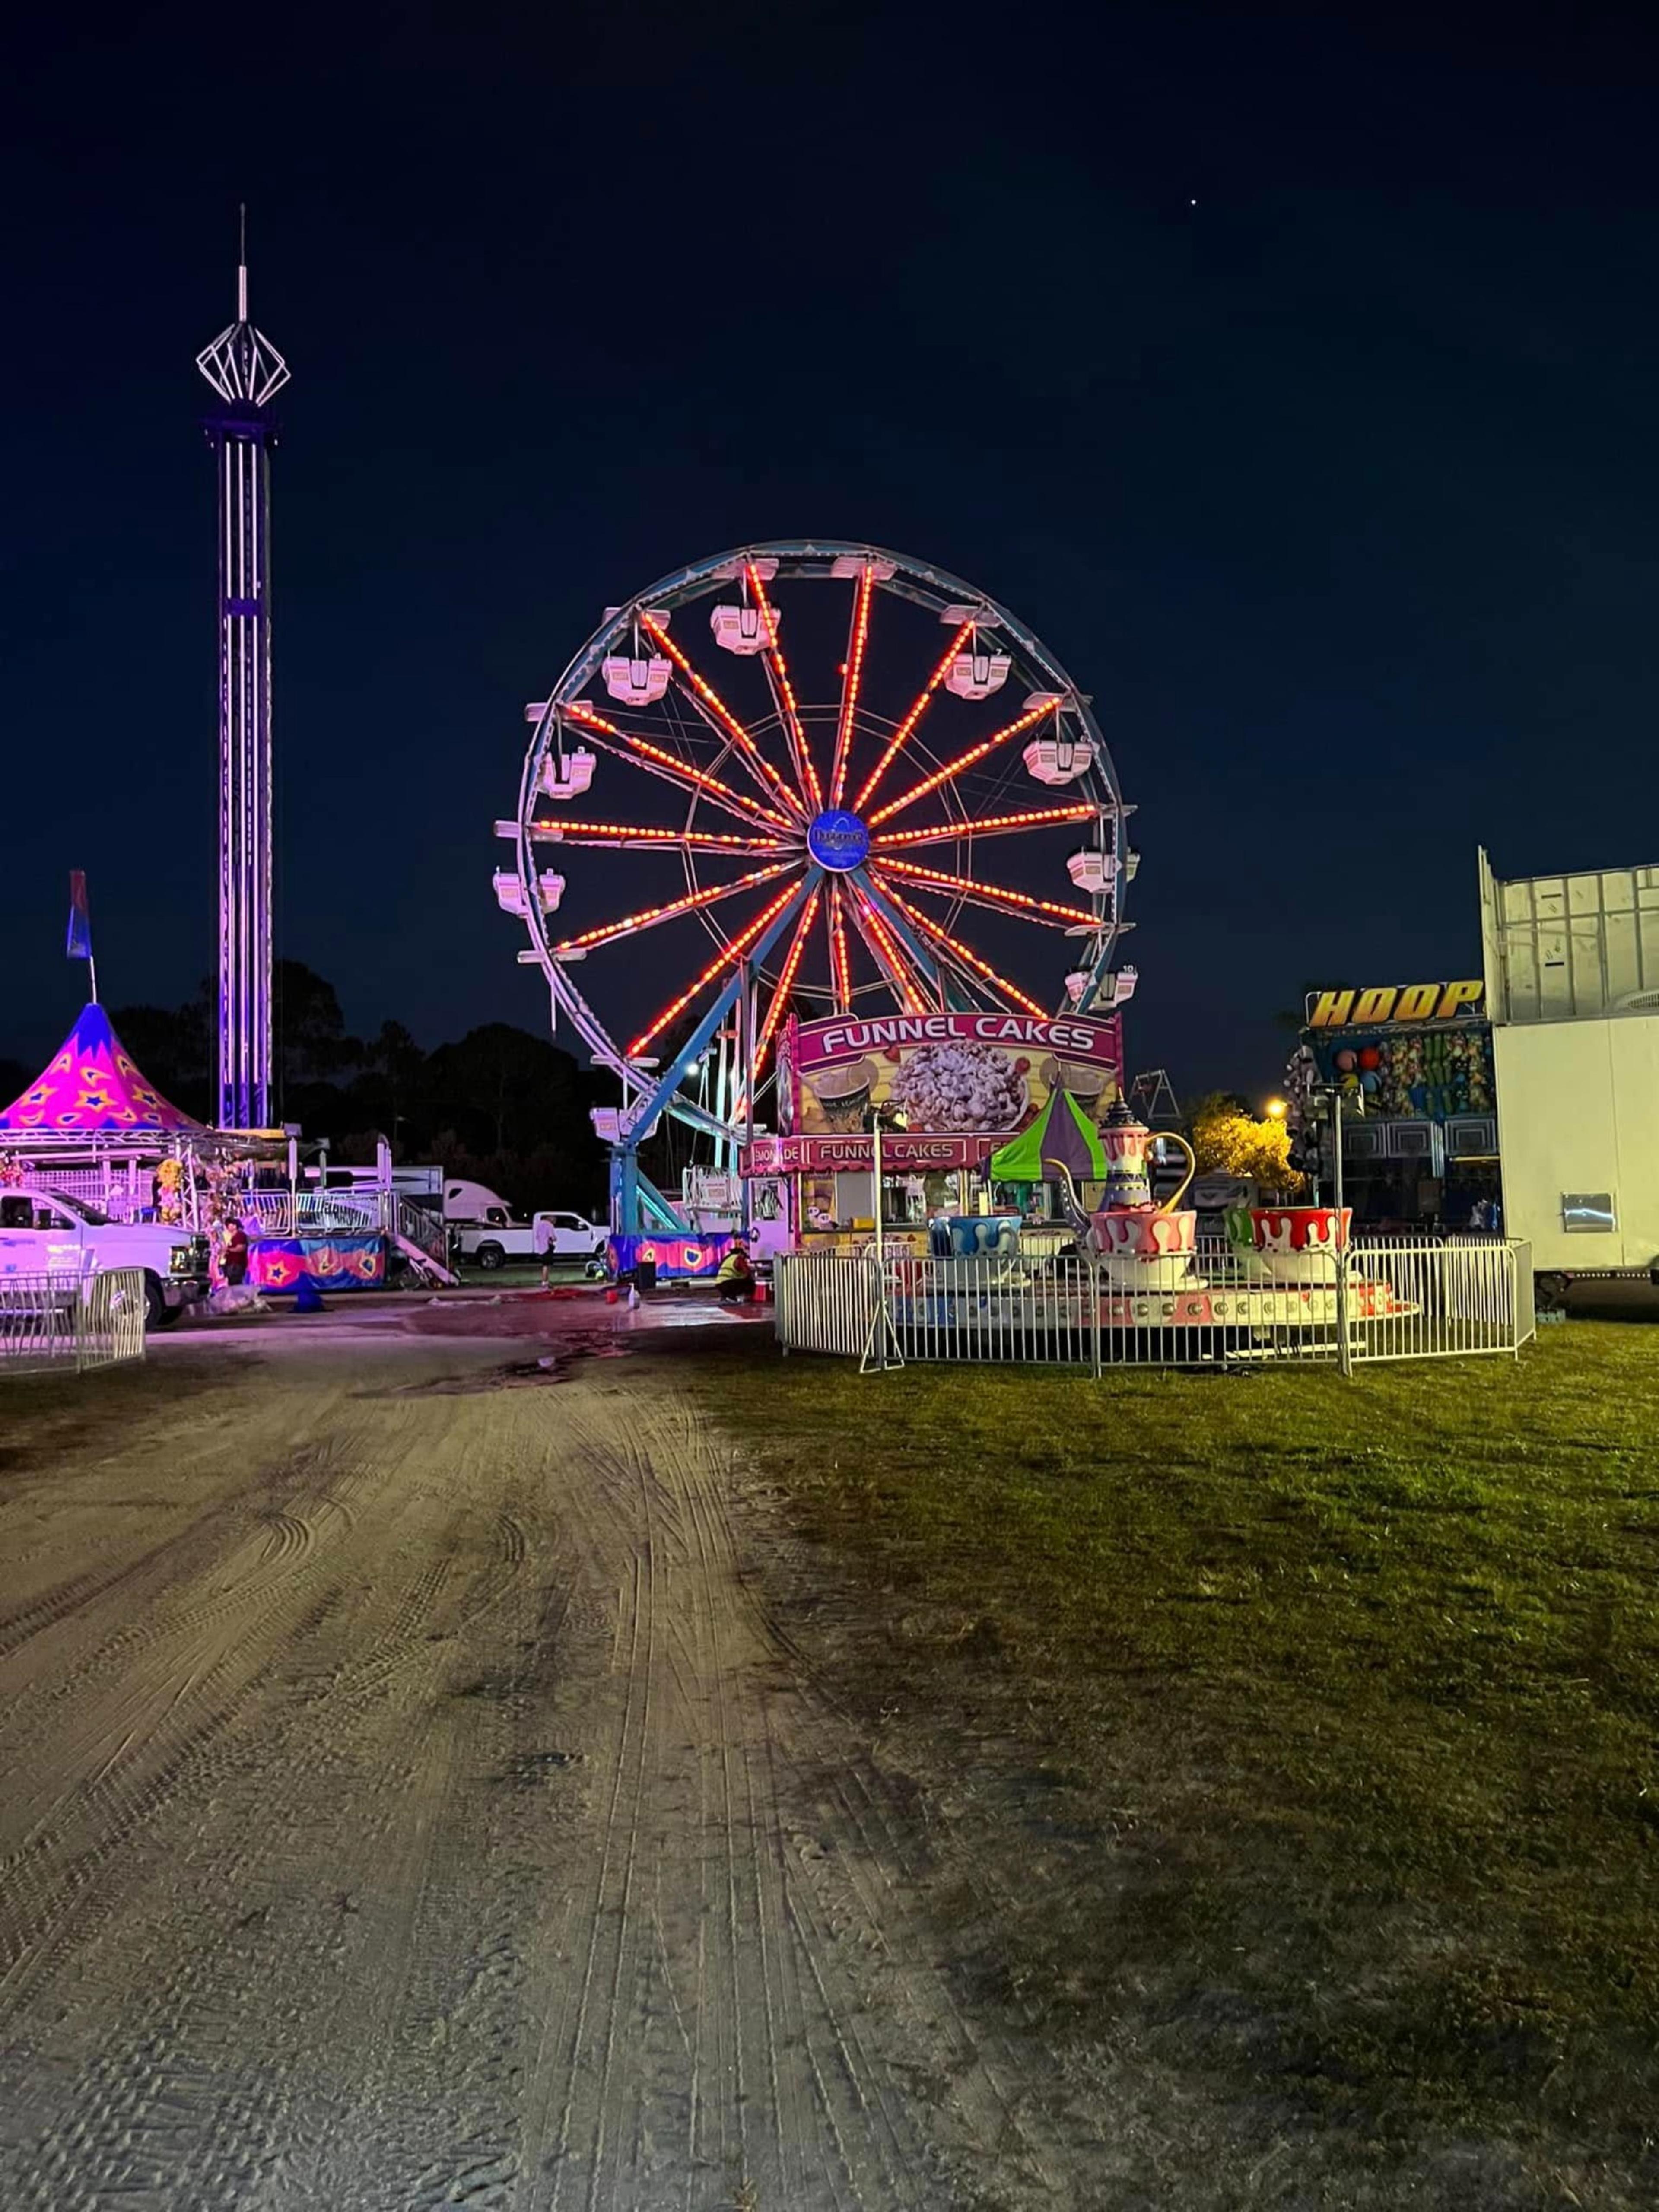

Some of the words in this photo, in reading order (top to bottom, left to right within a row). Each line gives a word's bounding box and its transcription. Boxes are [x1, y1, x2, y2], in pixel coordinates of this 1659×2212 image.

[1123, 964, 1134, 973] 10
[1309, 980, 1486, 1027] HOOP
[823, 1017, 966, 1053] FUNNEL
[975, 1017, 1095, 1050] CAKES
[894, 1143, 954, 1158] CAKES
